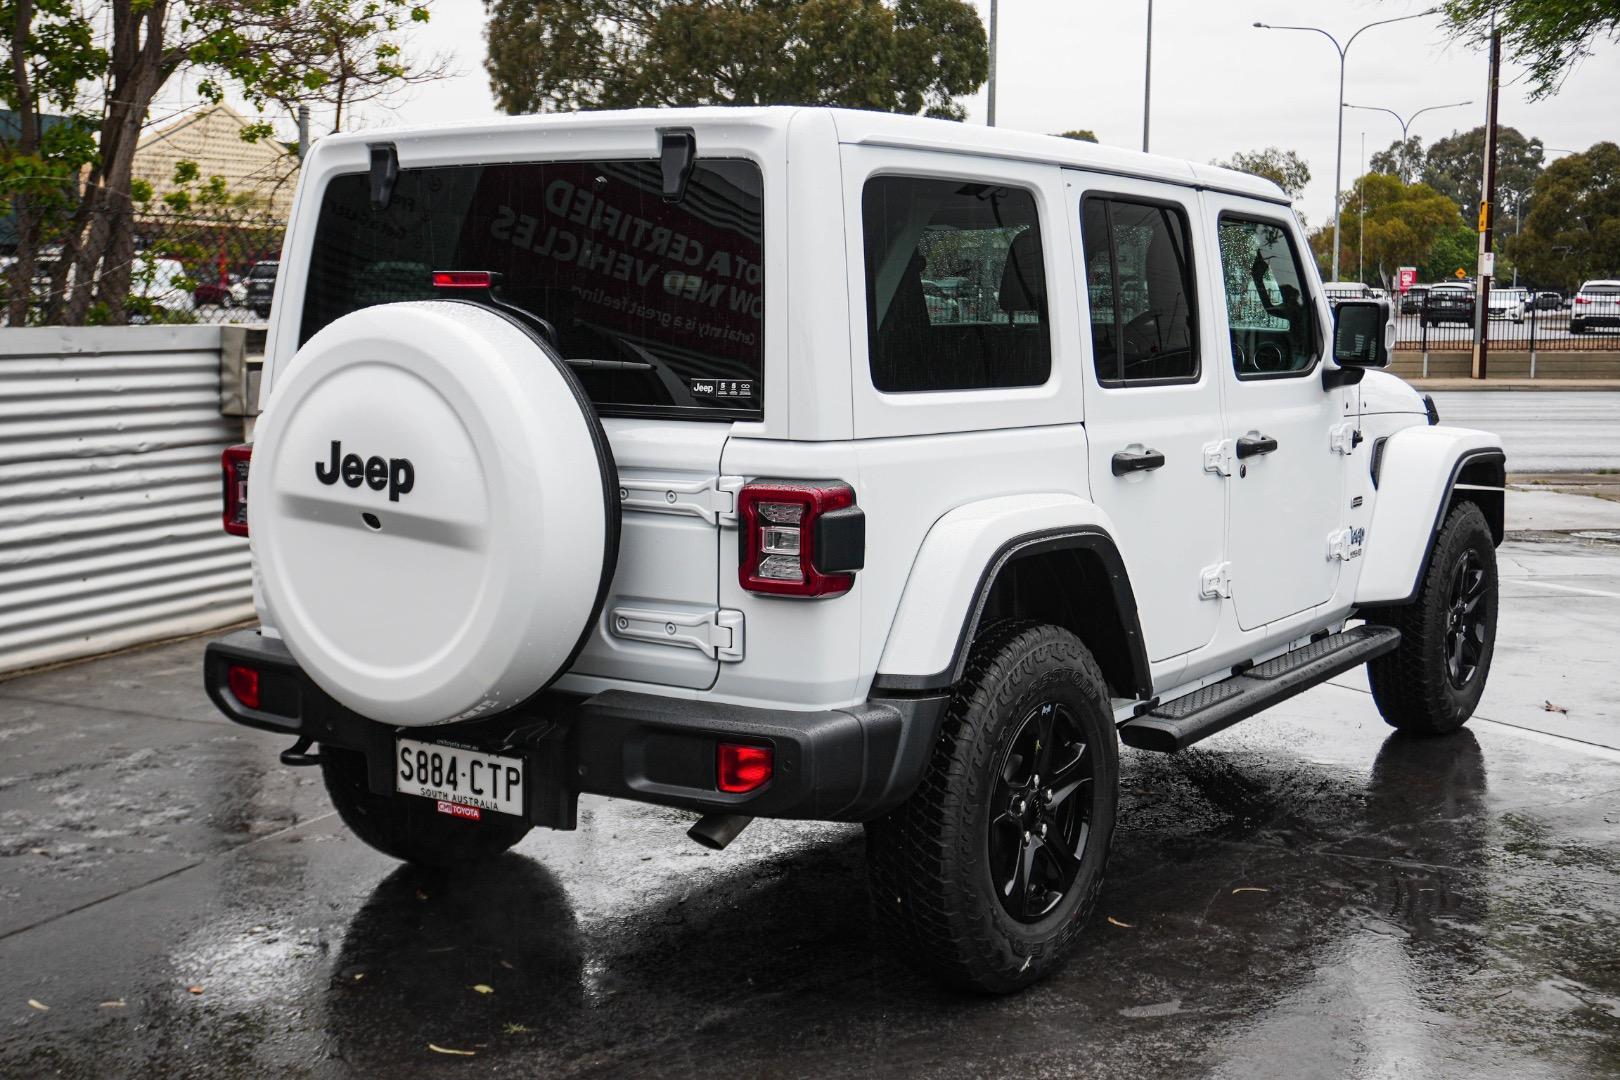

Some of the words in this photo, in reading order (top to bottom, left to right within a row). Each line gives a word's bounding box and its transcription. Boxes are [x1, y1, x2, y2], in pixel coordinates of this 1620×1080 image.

[693, 382, 714, 394] Jeep
[314, 439, 415, 502] Jeep
[420, 787, 448, 800] SOUTH
[452, 794, 499, 811] AUSTRALIA
[452, 805, 480, 818] TOYOTA
